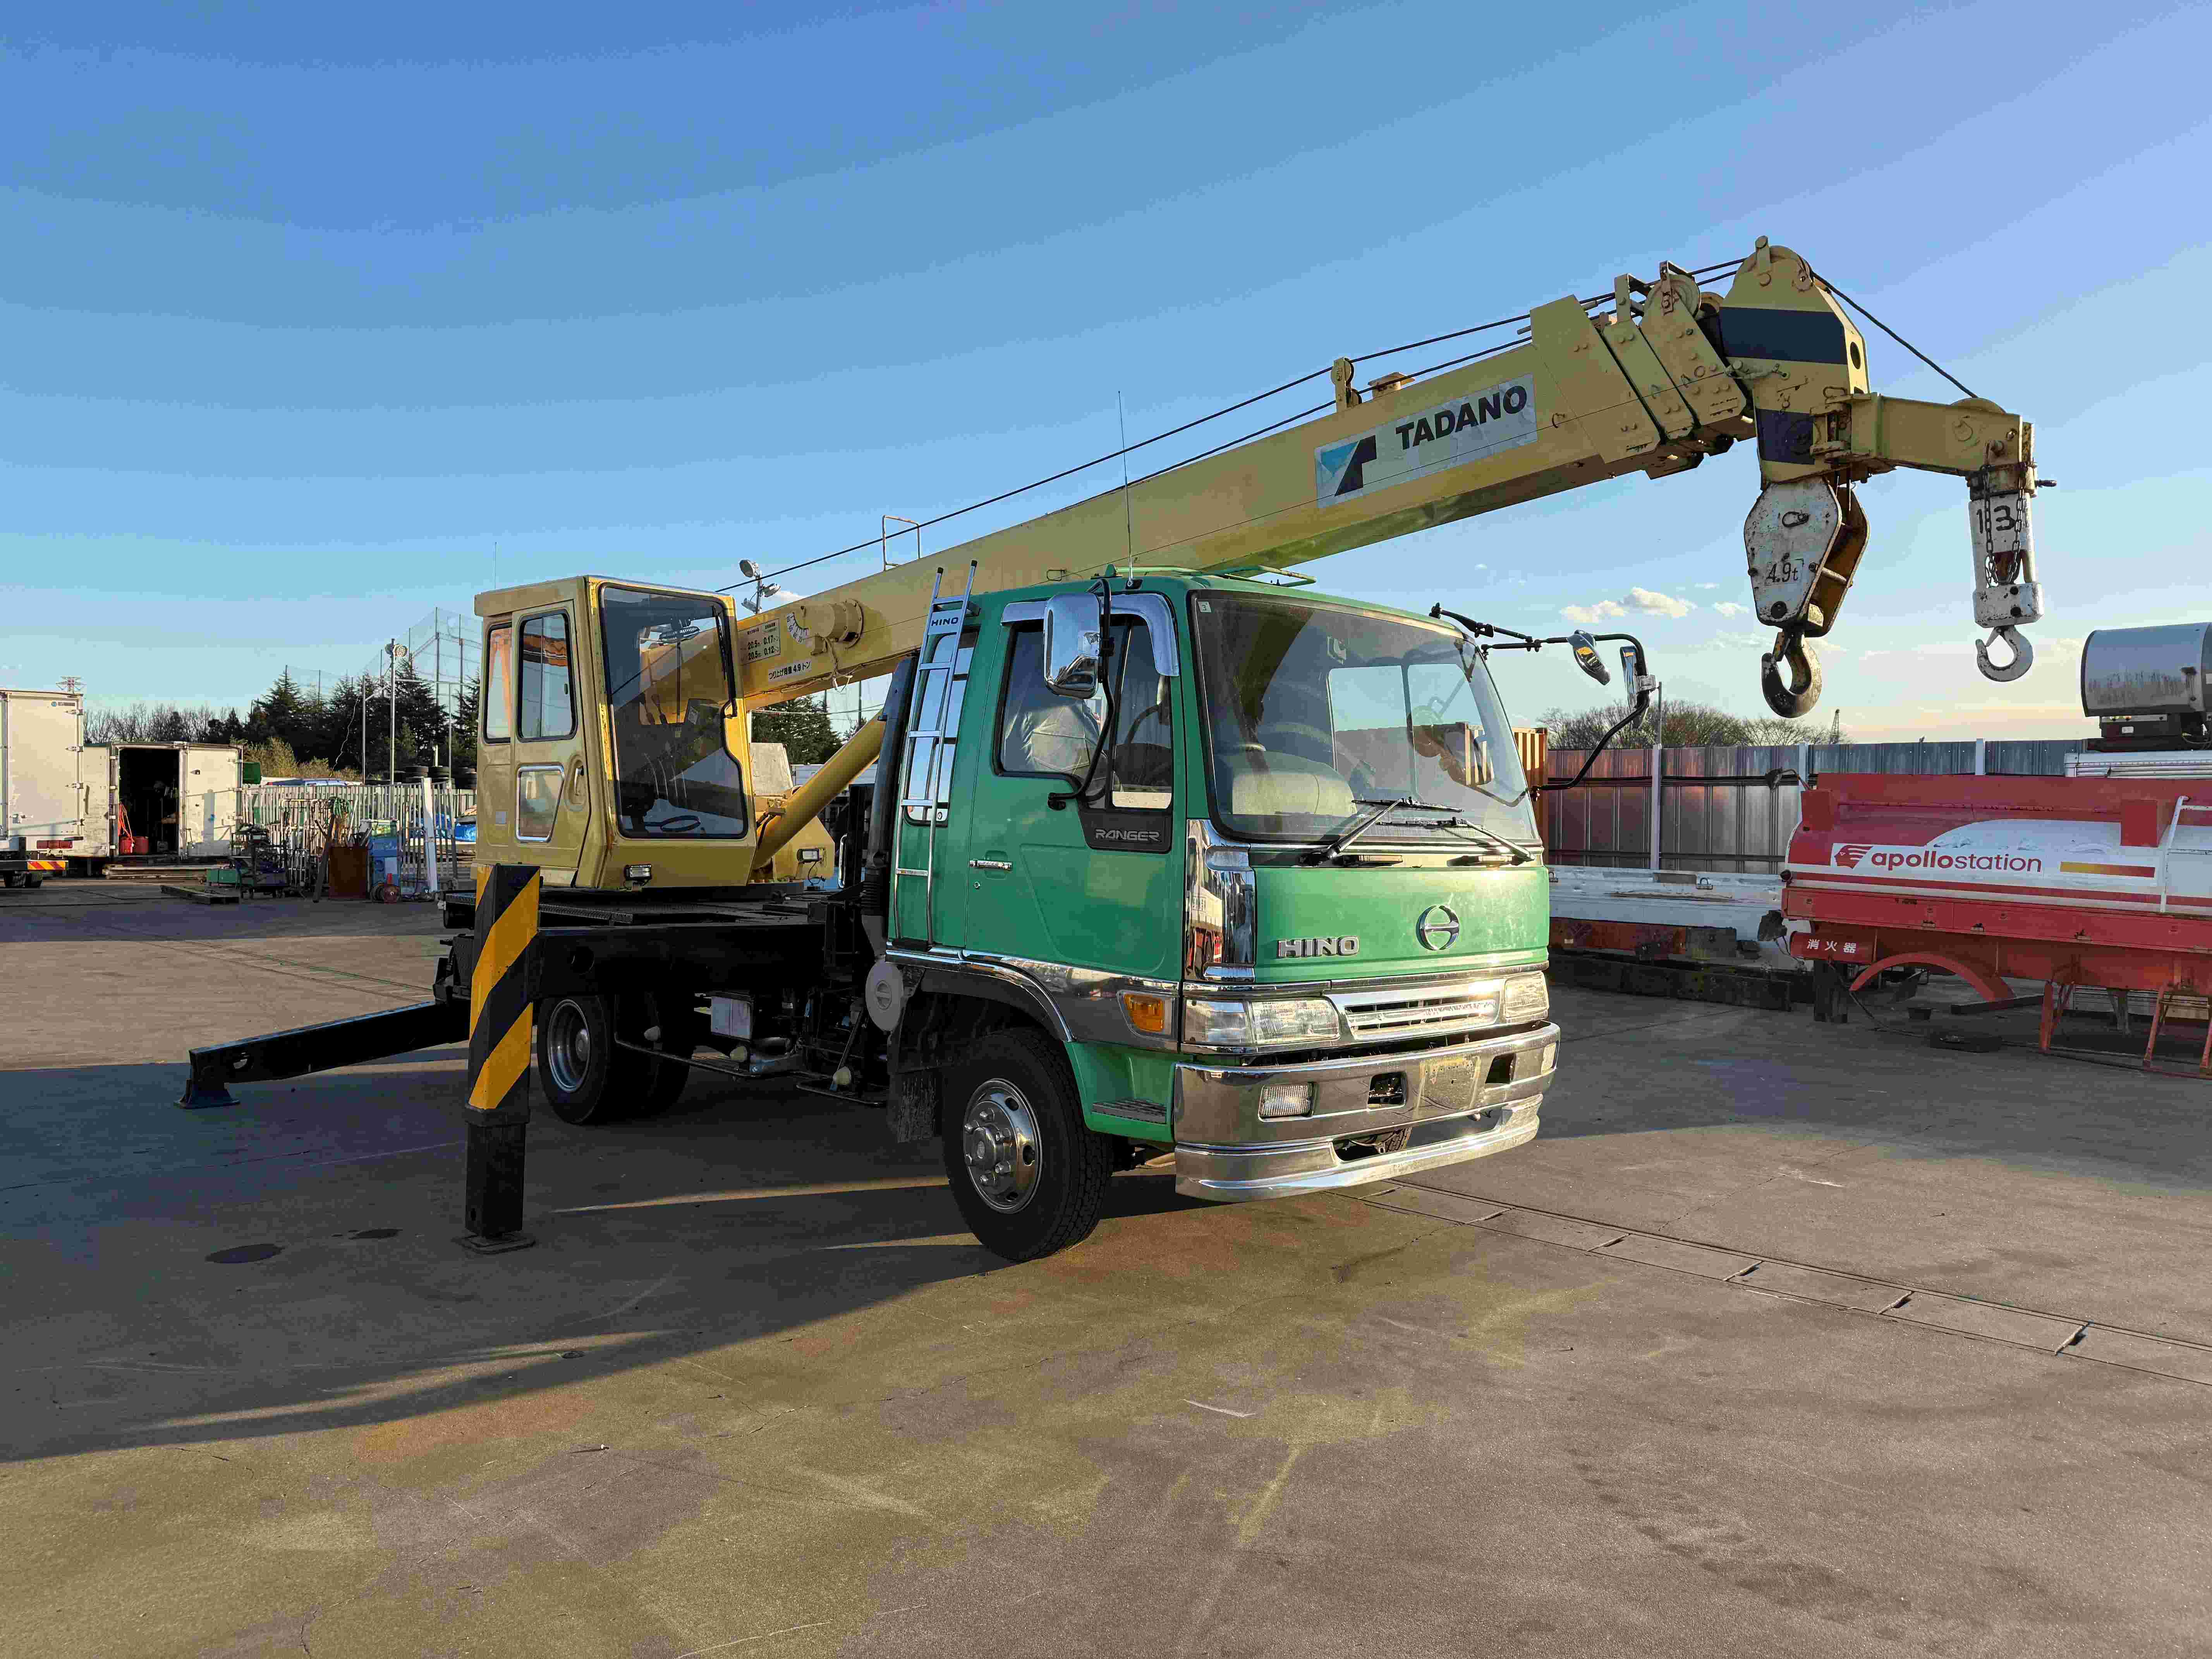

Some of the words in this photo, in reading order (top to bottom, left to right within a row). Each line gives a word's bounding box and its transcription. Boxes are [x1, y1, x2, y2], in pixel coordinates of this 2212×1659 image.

[1395, 386, 1527, 450] TADANO
[1766, 562, 1798, 582] 4.9t
[931, 617, 958, 626] HINO
[1095, 828, 1162, 842] RANGER
[1871, 850, 2042, 872] apollostation
[1277, 936, 1359, 958] HINO
[1807, 939, 1856, 953] 消火器
